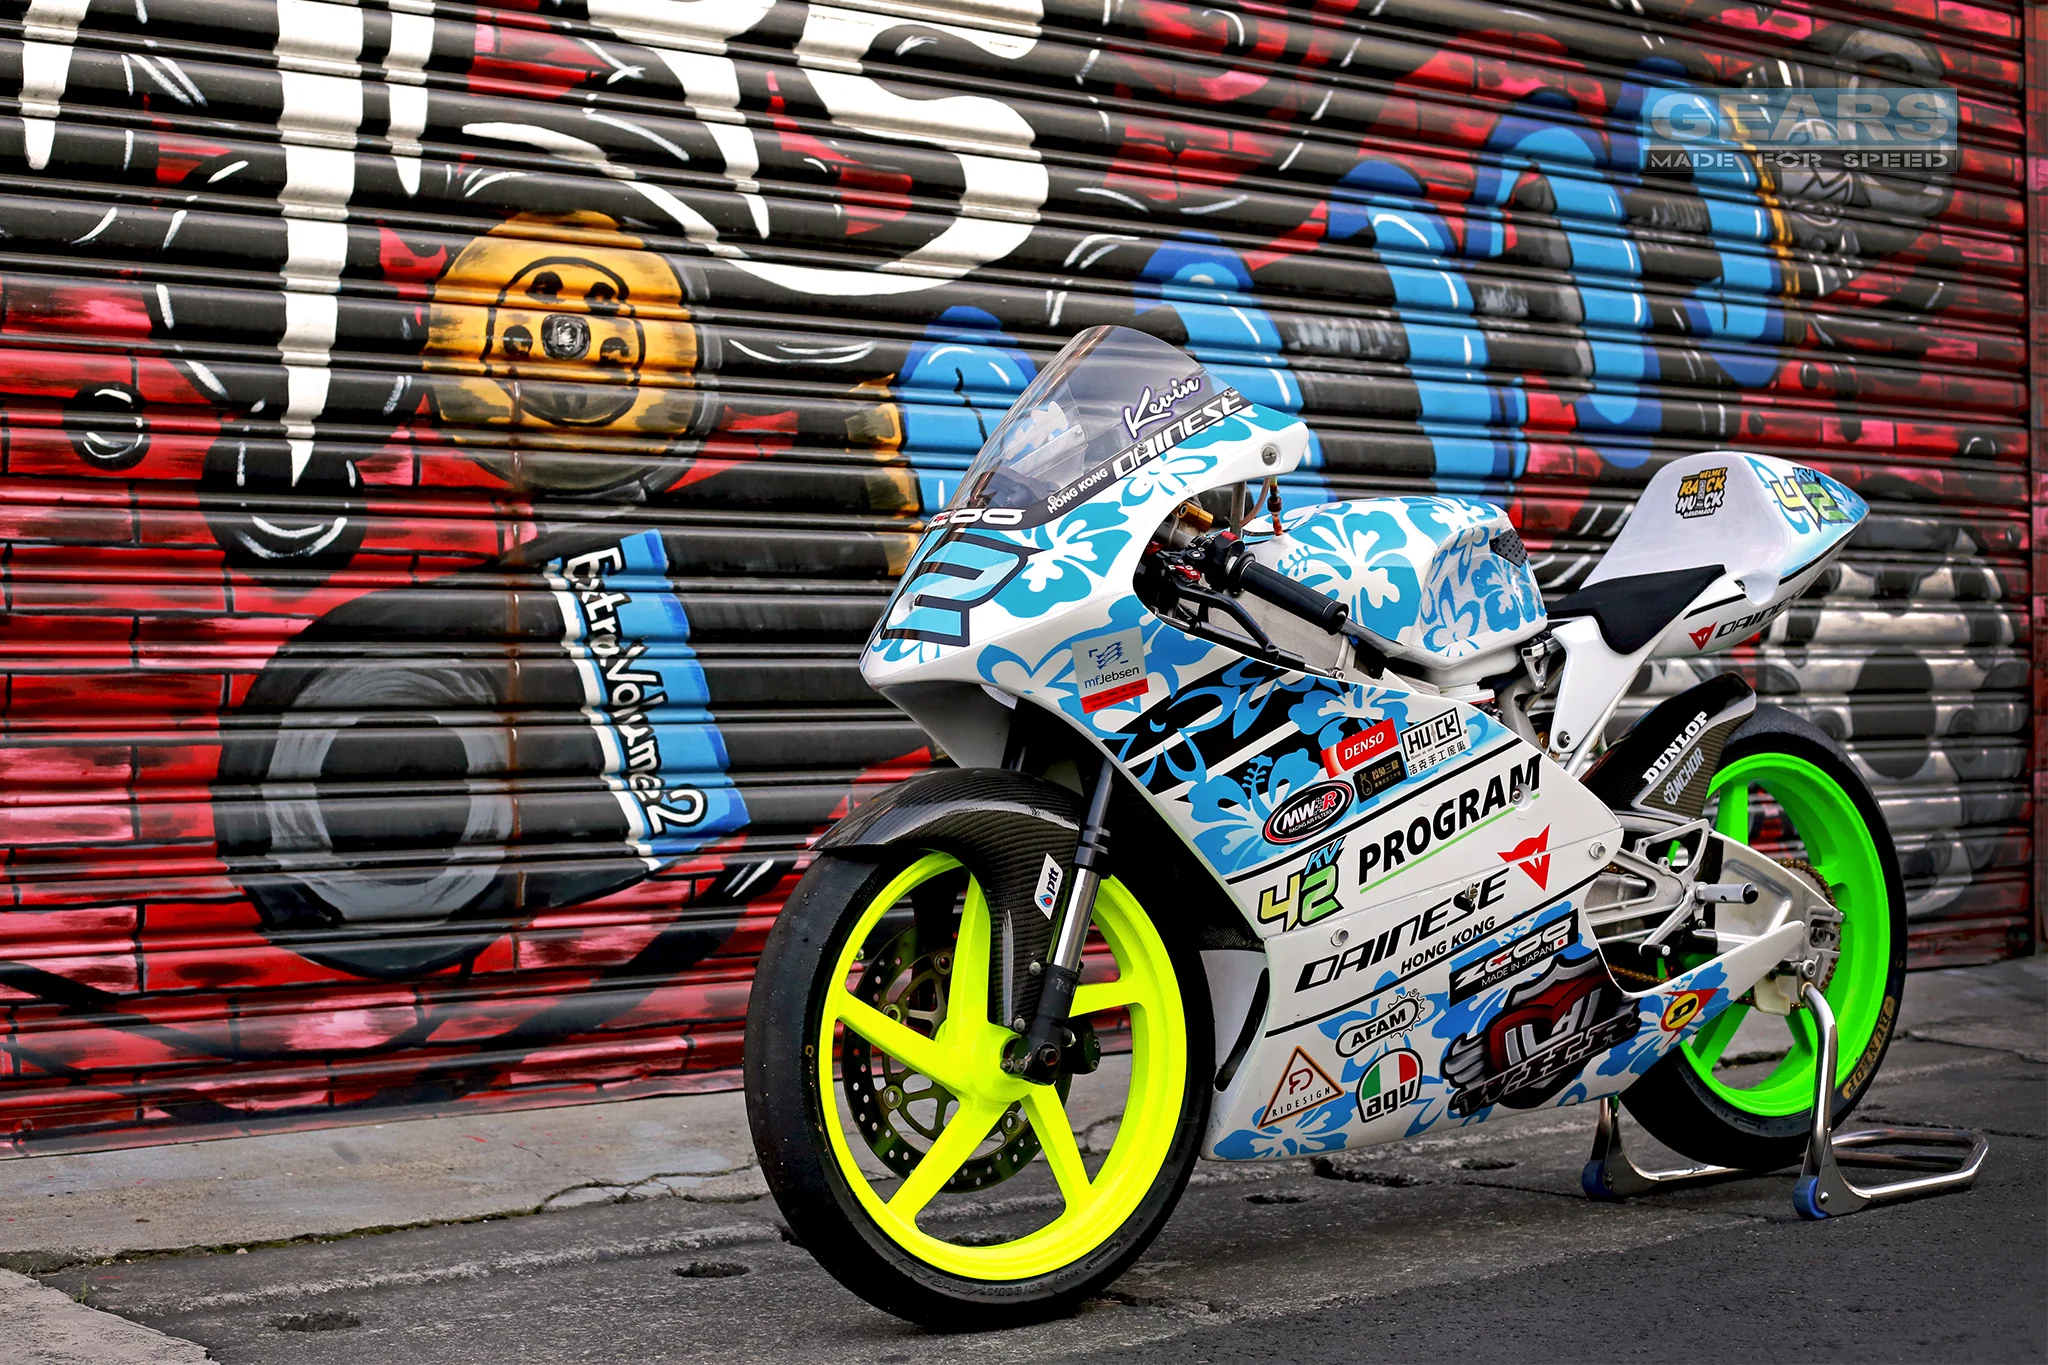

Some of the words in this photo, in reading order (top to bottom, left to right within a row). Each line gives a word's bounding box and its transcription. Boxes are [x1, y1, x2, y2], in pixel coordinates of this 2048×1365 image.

[1123, 376, 1200, 439] Kevin
[1047, 488, 1078, 513] HONG
[1078, 468, 1109, 492] KONG
[1112, 388, 1243, 480] DAINESE
[1769, 475, 1854, 533] 42
[1714, 580, 1811, 640] DAINE
[1084, 667, 1140, 688] mfJebsen
[1344, 731, 1385, 760] DENSO
[1642, 711, 1708, 785] DUNLOP
[1288, 822, 1307, 834] RACING
[1358, 753, 1543, 886] PROGRAM
[1046, 866, 1060, 896] ptt
[1257, 862, 1345, 933] 42
[1294, 867, 1510, 993] DAINESE
[1400, 940, 1448, 975] HONG
[1451, 915, 1496, 949] KONG
[1481, 966, 1510, 987] MADE
[1510, 960, 1521, 972] IN
[1522, 943, 1553, 966] JAPAN
[1351, 1008, 1407, 1048] AFAM
[1272, 1086, 1331, 1117] RIDESIGN
